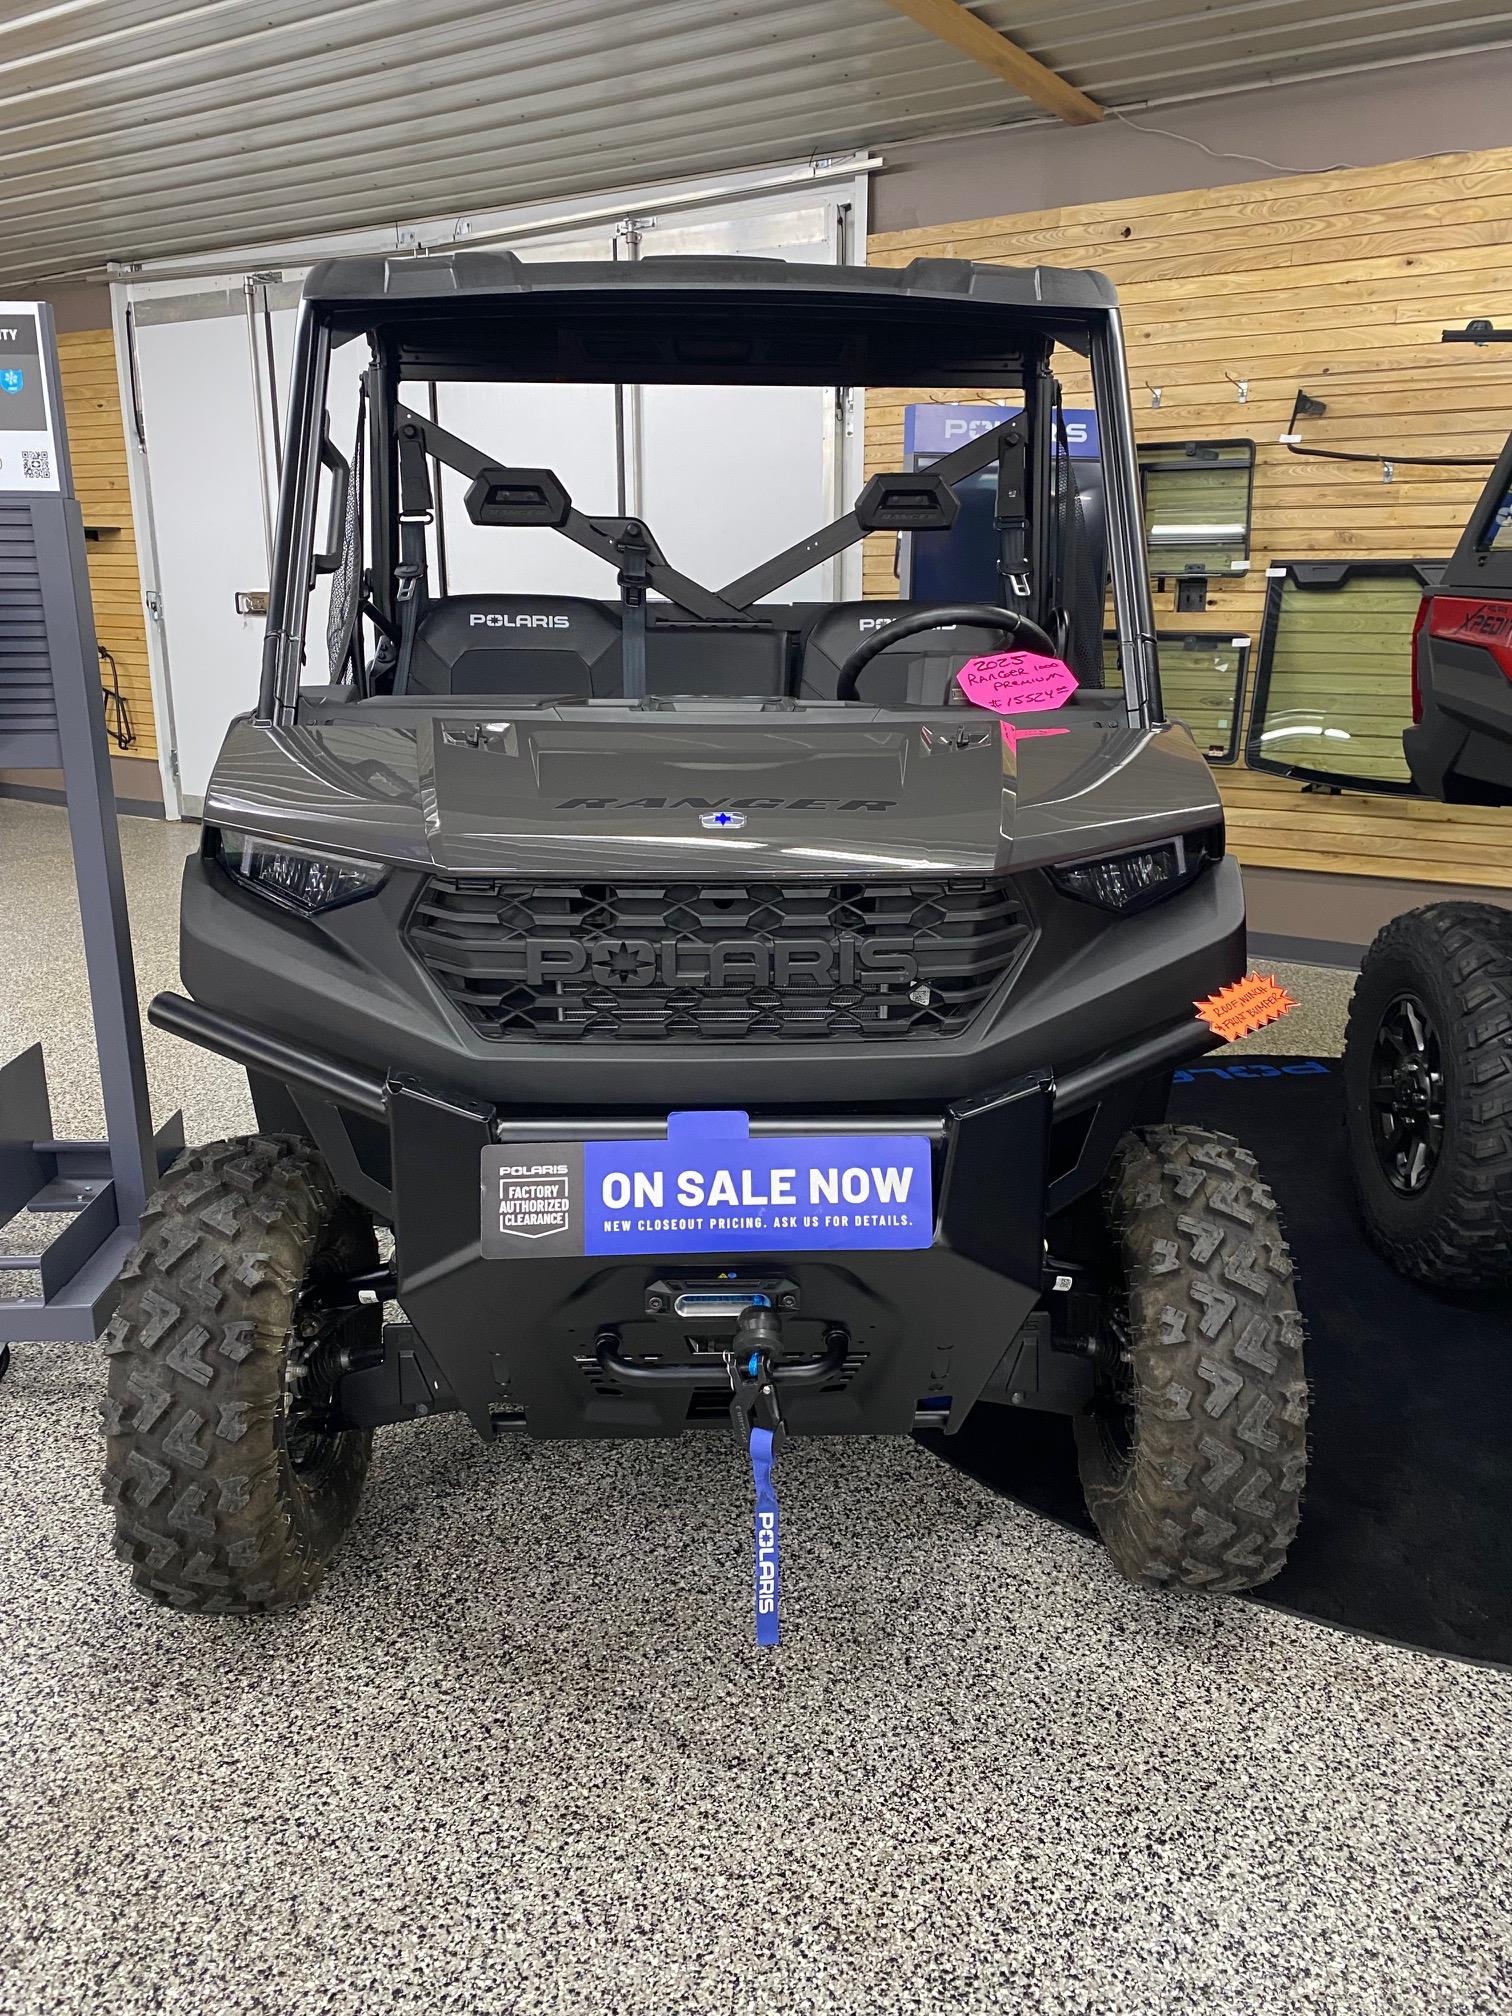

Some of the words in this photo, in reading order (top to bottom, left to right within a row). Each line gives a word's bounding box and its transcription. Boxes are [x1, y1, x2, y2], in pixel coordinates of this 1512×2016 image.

[0, 328, 18, 341] TY
[469, 614, 570, 628] POLARIS
[973, 654, 1028, 671] 2025
[552, 797, 898, 812] RANGER
[526, 936, 919, 987] POLARIS
[499, 1165, 569, 1176] POLARIS
[508, 1185, 560, 1199] FACTORY
[602, 1171, 664, 1209] ON
[676, 1168, 797, 1207] SALE
[809, 1167, 914, 1204] NOW
[499, 1199, 570, 1214] AUTHORIZED
[504, 1213, 564, 1226] CLEARANCE
[604, 1220, 631, 1232] NEW
[637, 1218, 704, 1231] CLOSEOUT
[709, 1217, 767, 1229] PRICING.
[773, 1216, 797, 1228] ASK
[803, 1216, 819, 1227] US
[825, 1215, 849, 1227] FOR
[854, 1214, 913, 1227] DETAILS.
[758, 1511, 774, 1615] POLARIS
